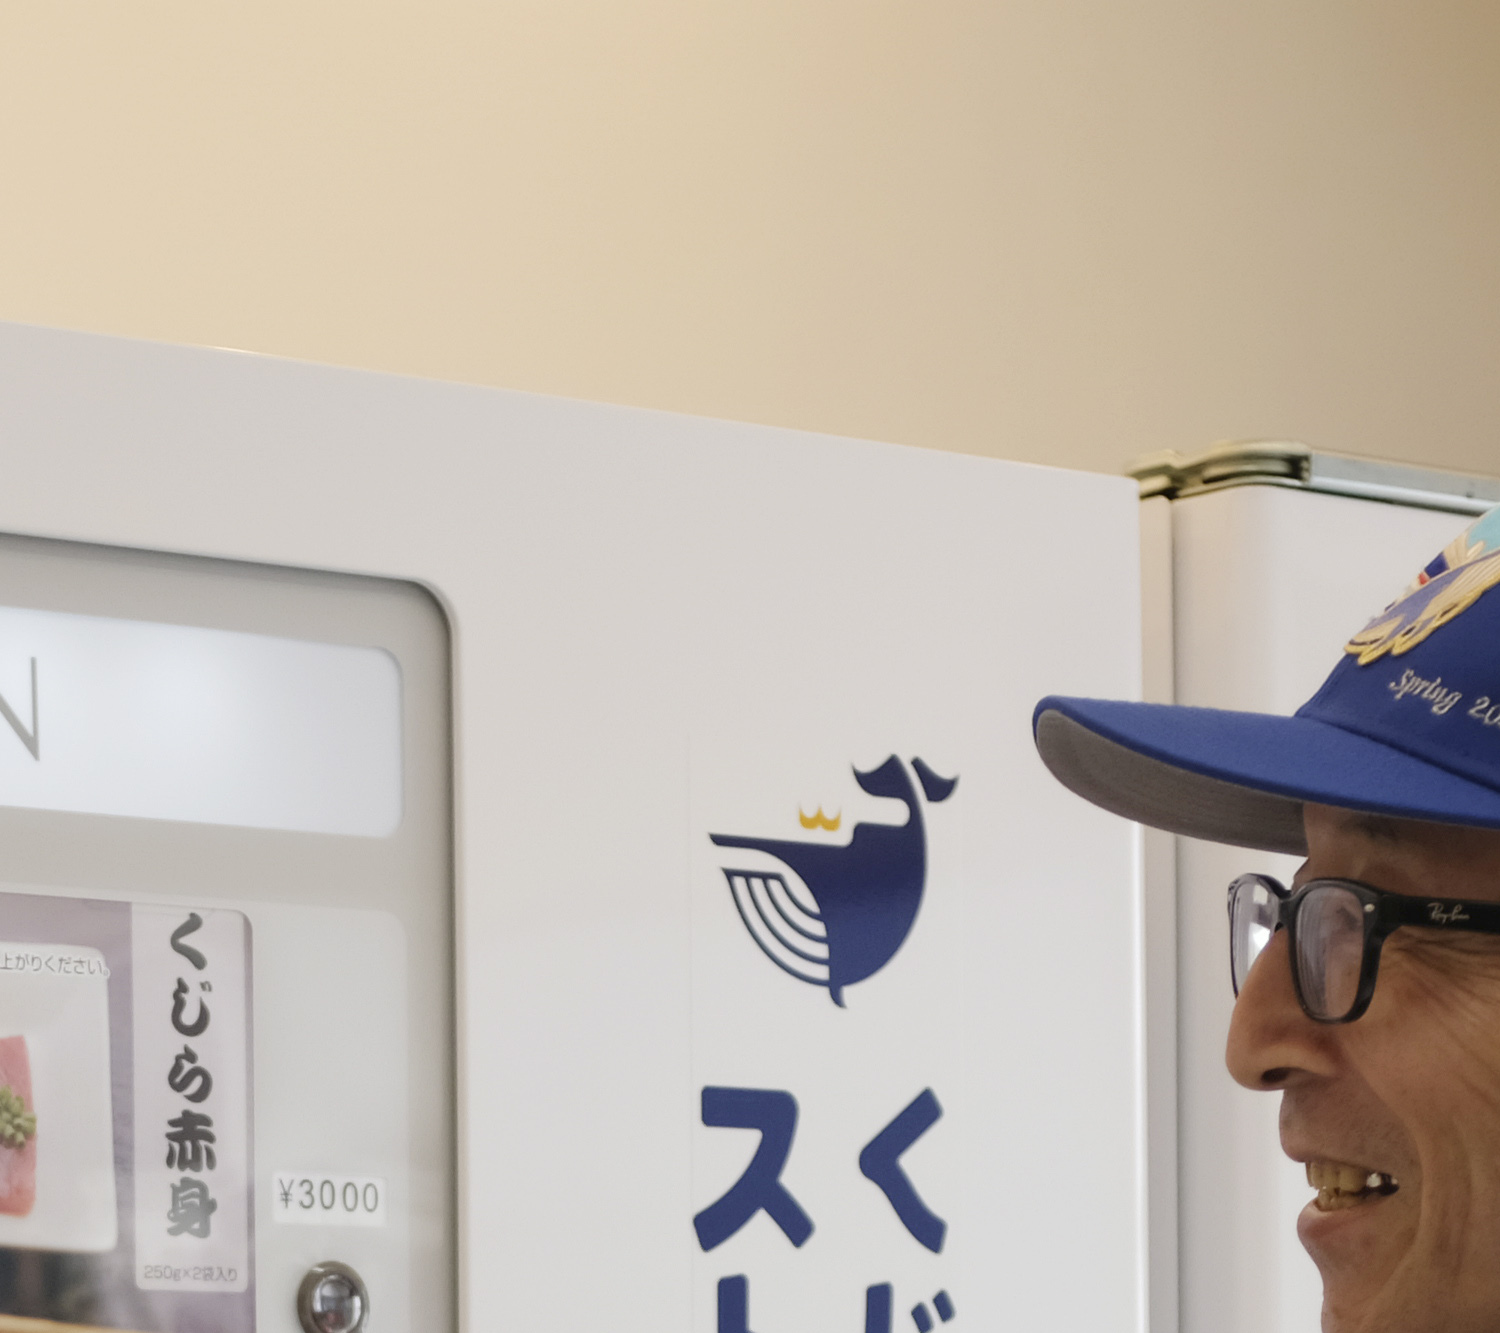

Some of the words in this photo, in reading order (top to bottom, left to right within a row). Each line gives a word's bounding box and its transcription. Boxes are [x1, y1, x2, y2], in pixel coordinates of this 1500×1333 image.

[1388, 668, 1462, 715] Spring
[165, 912, 217, 1239] くじら赤身
[278, 1178, 379, 1213] ¥3000
